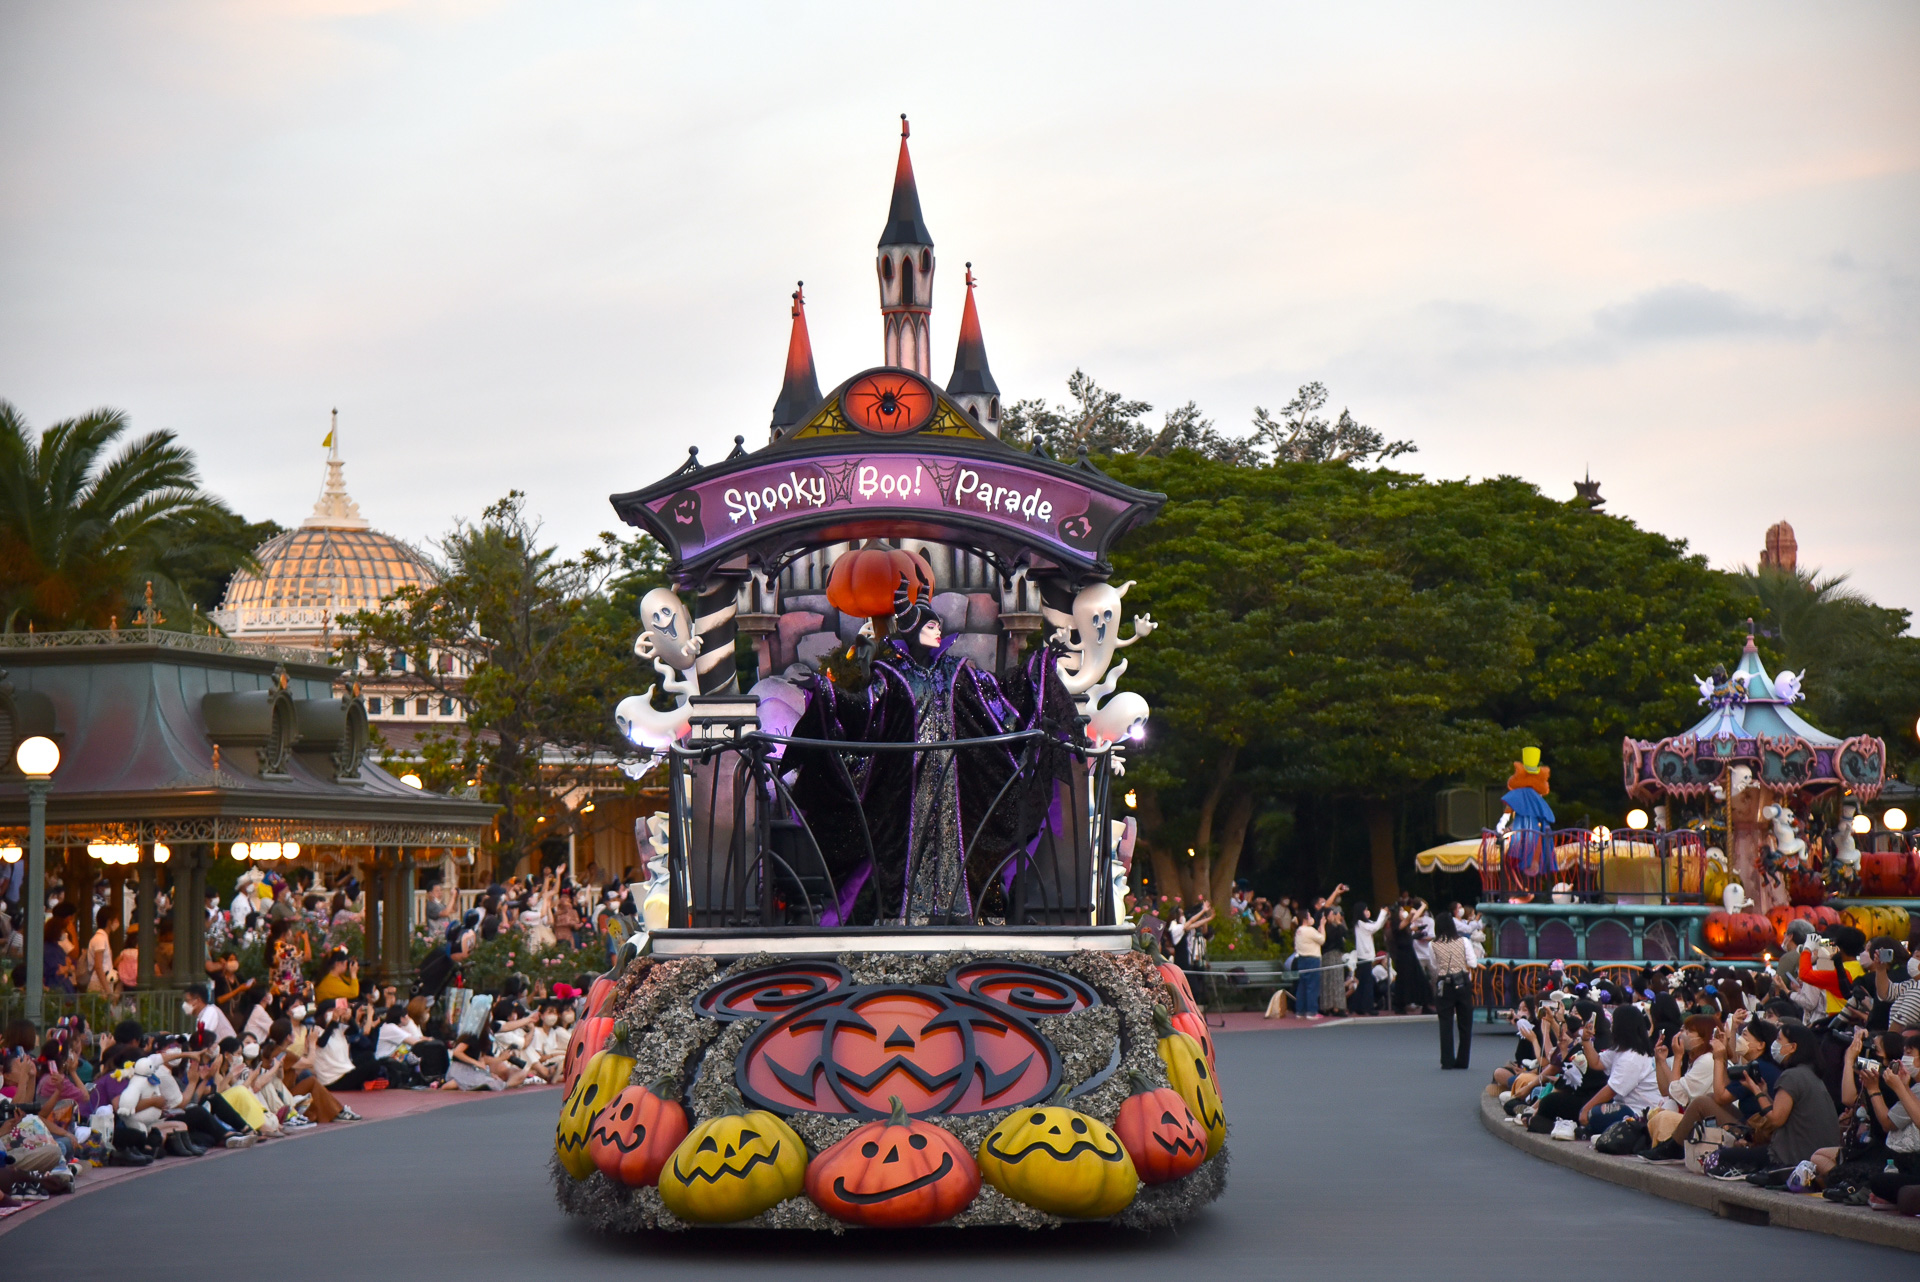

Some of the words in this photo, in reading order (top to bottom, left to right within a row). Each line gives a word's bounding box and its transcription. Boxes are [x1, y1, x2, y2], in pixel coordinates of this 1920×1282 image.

[724, 471, 826, 525] Spooky
[858, 465, 922, 500] Boo!
[955, 468, 1053, 523] Parade
